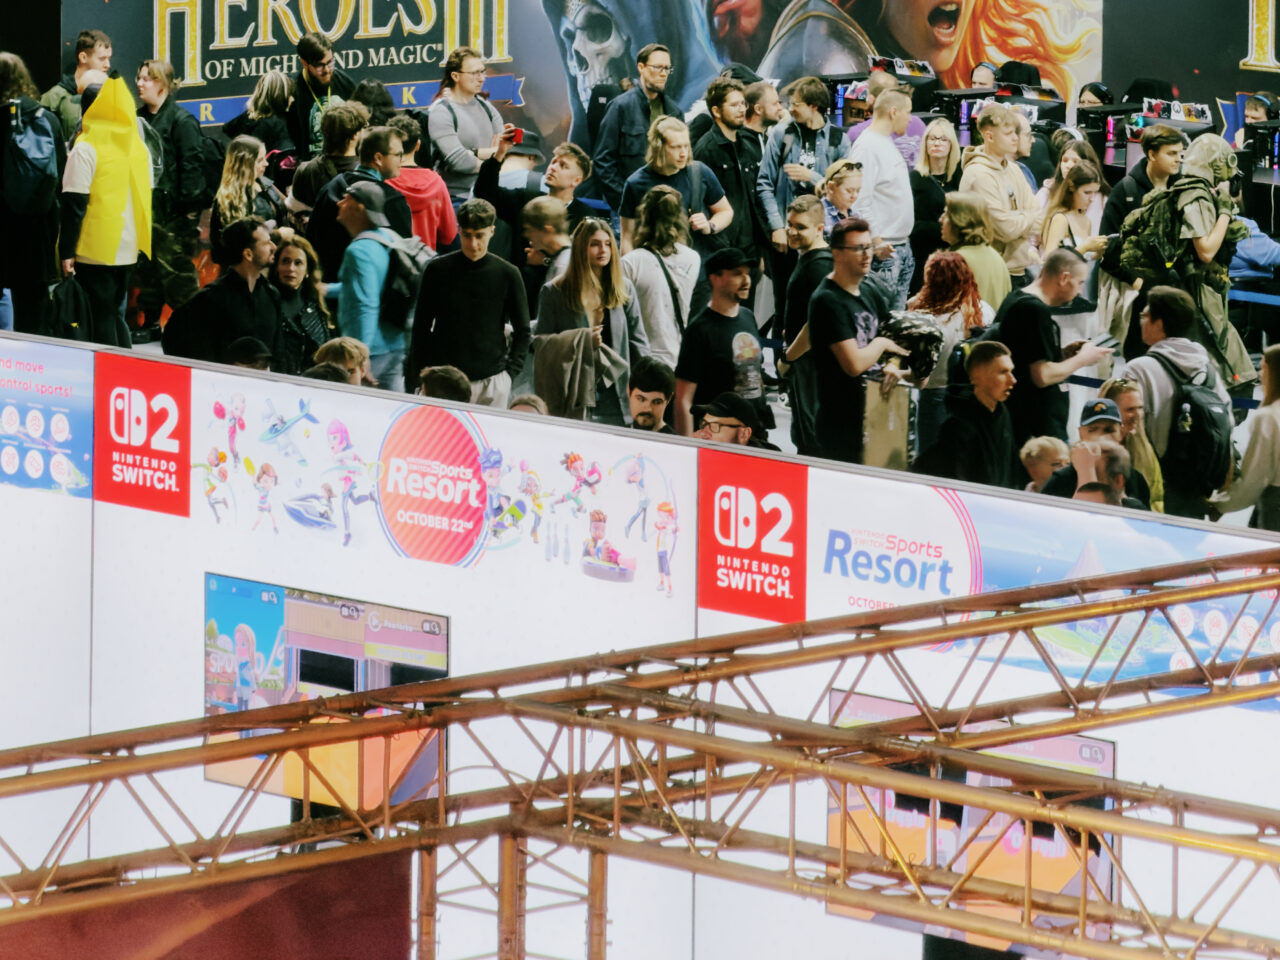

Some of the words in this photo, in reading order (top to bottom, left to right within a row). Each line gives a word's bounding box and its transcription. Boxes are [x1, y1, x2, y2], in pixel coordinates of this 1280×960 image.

[205, 58, 234, 80] OF
[239, 54, 301, 77] MIGH
[331, 49, 364, 69] ND
[15, 361, 44, 374] move
[35, 384, 72, 398] sports!
[150, 393, 179, 453] 2
[112, 451, 177, 473] NINTENDO
[431, 461, 473, 479] Sports
[112, 464, 176, 492] SWITCH
[386, 457, 480, 507] Resort
[397, 509, 449, 530] OCTOBER
[760, 492, 794, 558] 2
[885, 534, 943, 558] Sports
[716, 554, 791, 577] NINTENDO
[823, 529, 953, 596] Resort
[716, 568, 790, 599] SWITCH
